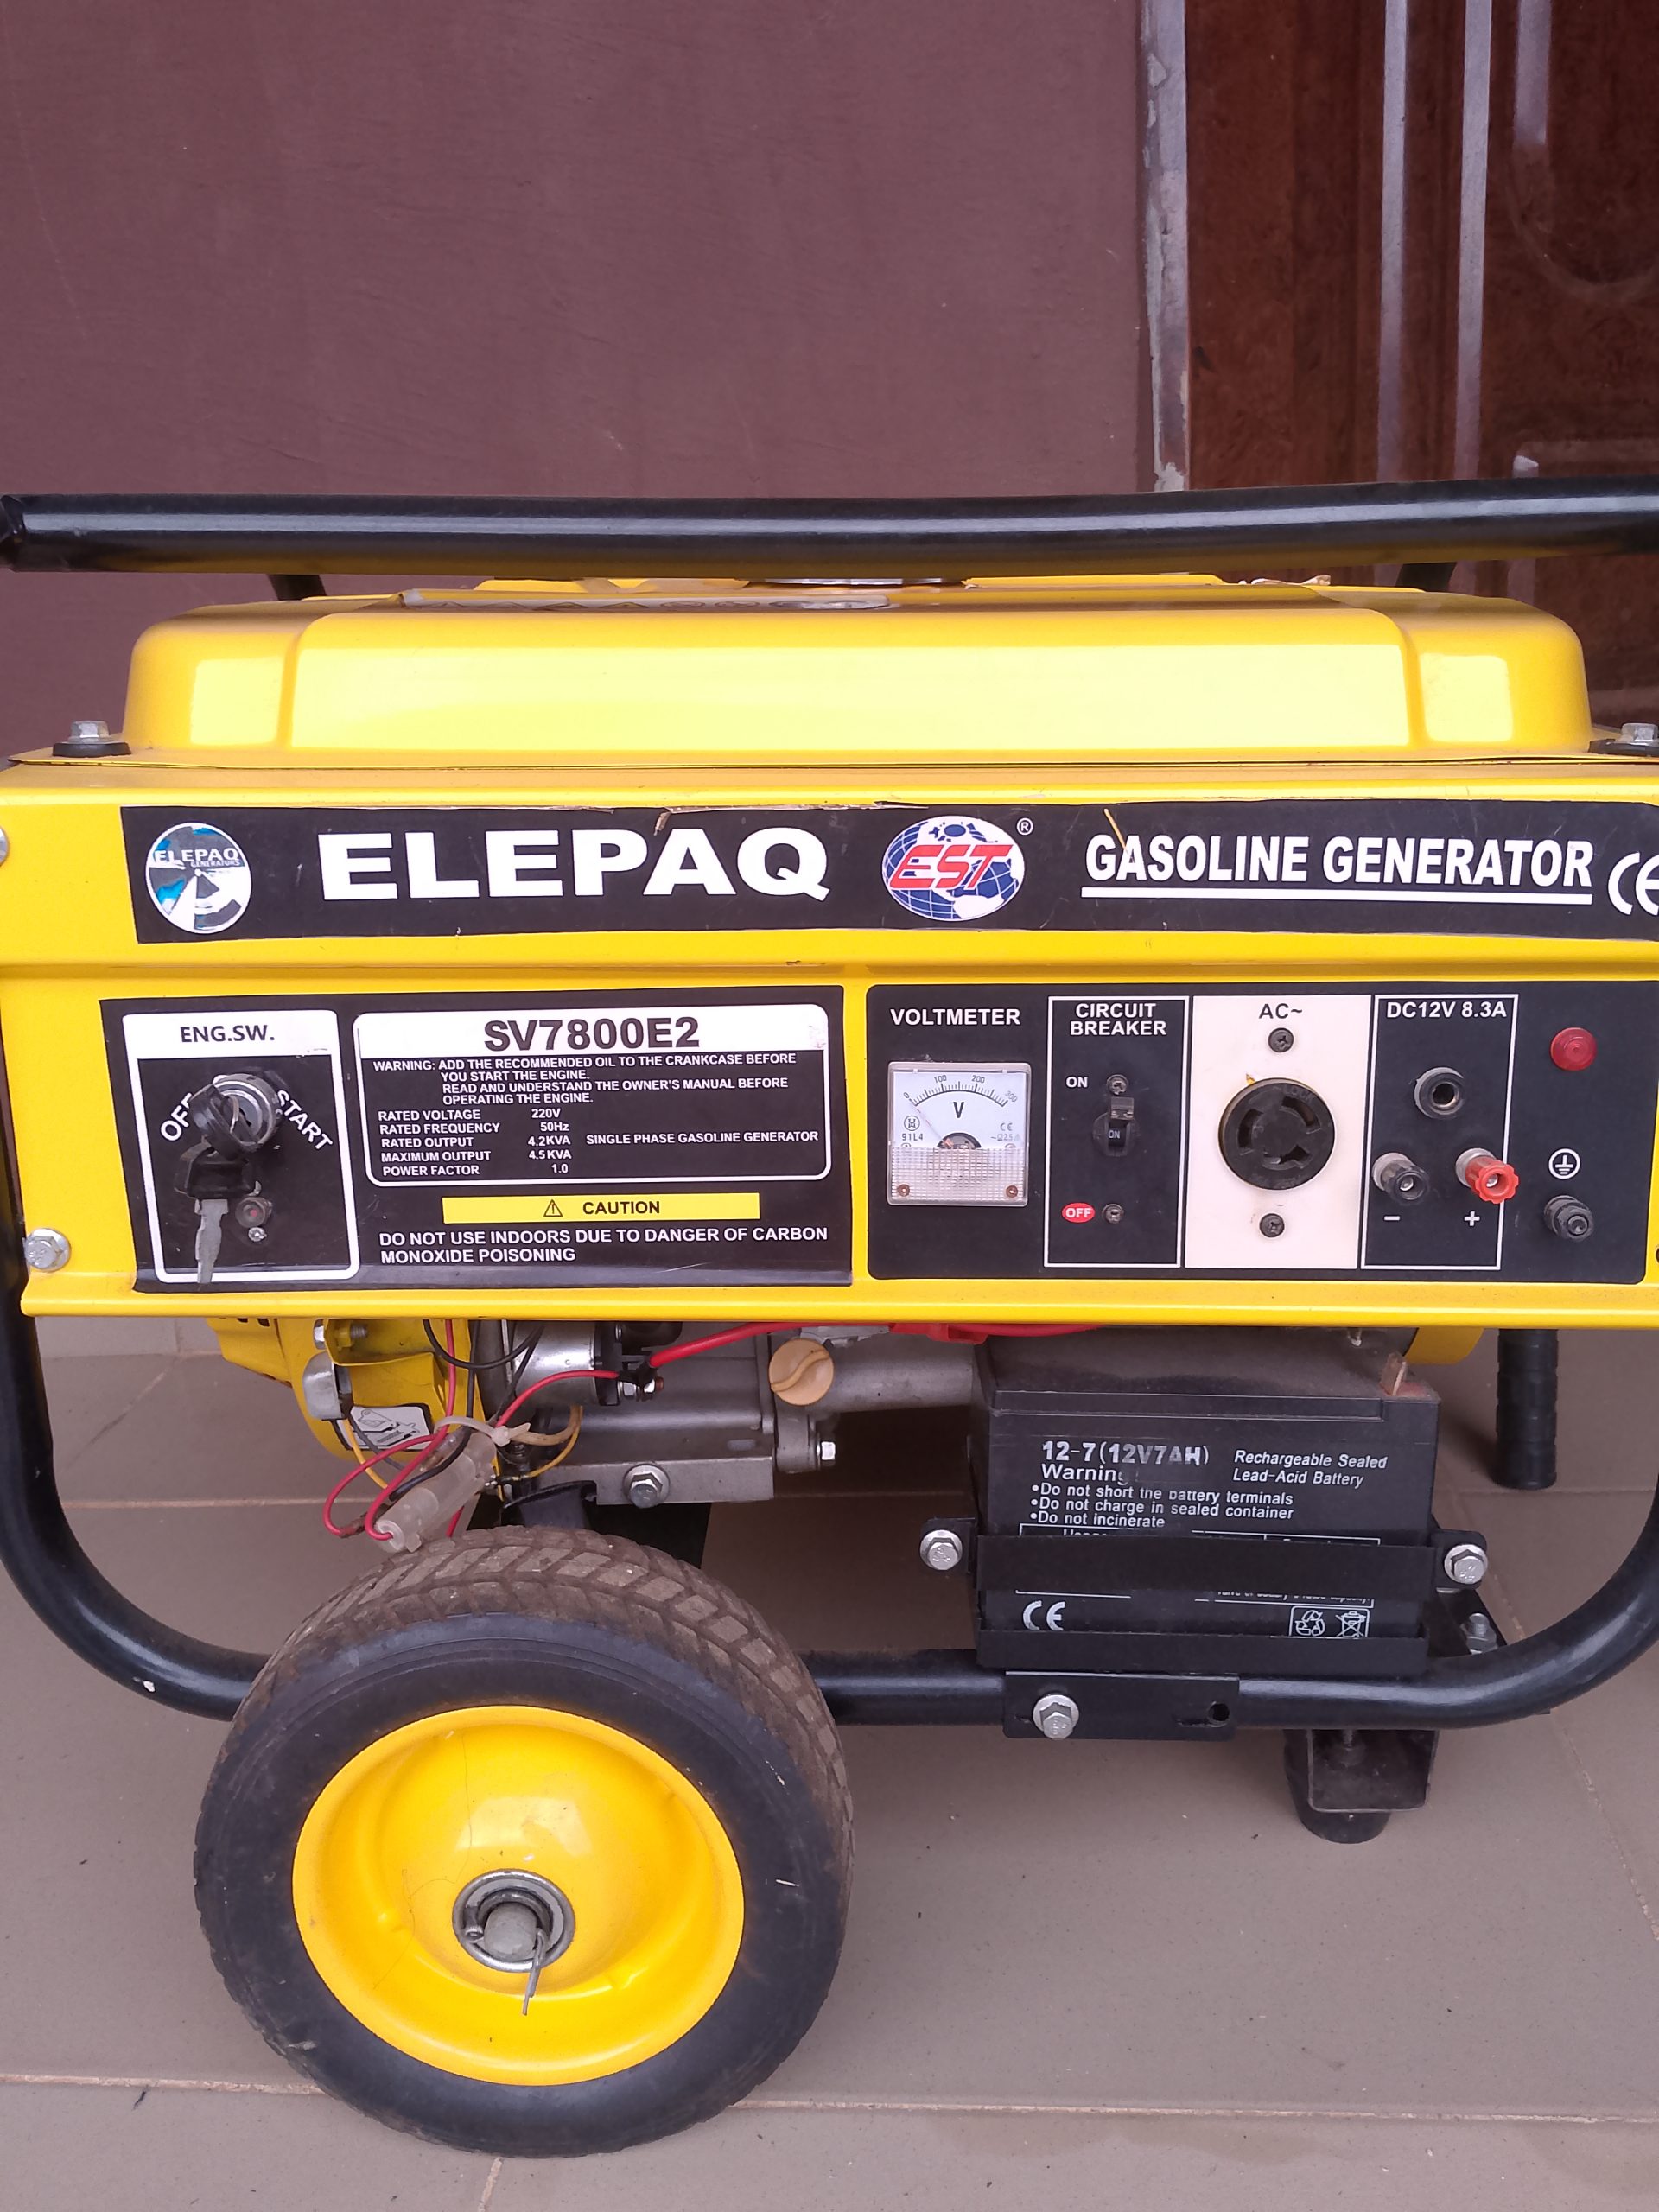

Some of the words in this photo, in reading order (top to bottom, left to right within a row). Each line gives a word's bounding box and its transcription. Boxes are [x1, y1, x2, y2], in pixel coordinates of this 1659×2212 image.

[155, 848, 239, 862] ELEPAQ
[1085, 834, 1310, 883] GASOLINE
[1323, 836, 1593, 887] GENERATOR
[318, 827, 830, 902] ELEPAQ
[890, 844, 1014, 890] EST
[890, 1008, 1020, 1026] VOLTMETER
[1076, 1003, 1156, 1019] CIRCUIT
[1387, 1001, 1455, 1018] DC12V
[1461, 1001, 1507, 1018] 8.3A
[180, 1025, 275, 1043] ENG.SW.
[484, 1016, 700, 1052] SV7800E2
[1070, 1021, 1166, 1036] BREAKER
[373, 1060, 435, 1071] WARNING:
[439, 1060, 464, 1070] ADD
[467, 1059, 493, 1070] THE
[495, 1058, 592, 1069] RECOMMENDED
[595, 1057, 615, 1067] OIL
[619, 1056, 635, 1066] TO
[639, 1056, 662, 1066] THE
[665, 1054, 742, 1066] CRANKCASE
[746, 1053, 796, 1064] BEFORE
[441, 1072, 467, 1082] YOU
[470, 1071, 510, 1082] START
[512, 1071, 537, 1081] THE
[540, 1070, 589, 1080] ENGINE.
[971, 1075, 985, 1084] 200
[1066, 1077, 1088, 1088] ON
[443, 1084, 477, 1094] READ
[480, 1084, 505, 1093] AND
[509, 1081, 592, 1092] UNDERSTAND
[596, 1081, 620, 1090] THE
[622, 1079, 680, 1090] OWNER'S
[683, 1079, 734, 1090] MANUAL
[739, 1077, 788, 1088] BEFORE
[443, 1094, 513, 1105] OPERATING
[518, 1094, 540, 1103] THE
[543, 1092, 593, 1103] ENGINE.
[1005, 1090, 1018, 1103] 300
[378, 1111, 419, 1122] RATED
[423, 1109, 480, 1121] VOLTAGE
[531, 1109, 560, 1118] 220V
[953, 1102, 964, 1118] V
[277, 1090, 333, 1150] START
[380, 1124, 421, 1135] RATED
[423, 1123, 500, 1134] FREQUENCY
[540, 1122, 569, 1132] 50Hz
[1109, 1129, 1121, 1139] ON
[381, 1138, 421, 1148] RATED
[424, 1137, 474, 1147] OUTPUT
[528, 1135, 570, 1147] 4.2KVA
[587, 1135, 631, 1145] SINGLE
[634, 1134, 675, 1144] PHASE
[678, 1133, 740, 1143] GASOLINE
[744, 1131, 818, 1142] GENERATOR
[381, 1152, 439, 1162] MAXIMUM
[442, 1151, 491, 1161] OUTPUT
[383, 1166, 427, 1176] POWER
[431, 1165, 480, 1175] FACTOR
[552, 1163, 568, 1173] 1.0
[582, 1201, 660, 1215] CAUTION
[1065, 1207, 1091, 1218] OFF
[379, 1233, 405, 1246] DO
[410, 1232, 445, 1246] NOT
[450, 1231, 486, 1245] USE
[491, 1230, 570, 1244] INDOORS
[576, 1230, 611, 1243] DUE
[616, 1229, 639, 1243] TO
[645, 1228, 719, 1243] DANGER
[724, 1227, 747, 1241] OF
[753, 1226, 828, 1241] CARBON
[381, 1249, 474, 1263] MONOXIDE
[479, 1249, 575, 1262] POISONING
[1234, 1450, 1332, 1467] Rechargeable
[1338, 1454, 1388, 1469] Sealed
[1233, 1469, 1307, 1484] Lead-Acid
[1313, 1471, 1363, 1489] Battery
[1040, 1483, 1060, 1496] Do
[1067, 1484, 1090, 1497] not
[1096, 1485, 1134, 1498] short
[1226, 1491, 1294, 1505] terminals
[1039, 1497, 1059, 1510] Do
[1065, 1499, 1090, 1511] not
[1095, 1500, 1144, 1516] charge
[1152, 1502, 1164, 1513] in
[1171, 1503, 1219, 1516] sealed
[1225, 1504, 1294, 1519] container
[1038, 1511, 1058, 1523] Do
[1065, 1513, 1088, 1525] not
[1093, 1514, 1165, 1528] incinerate
